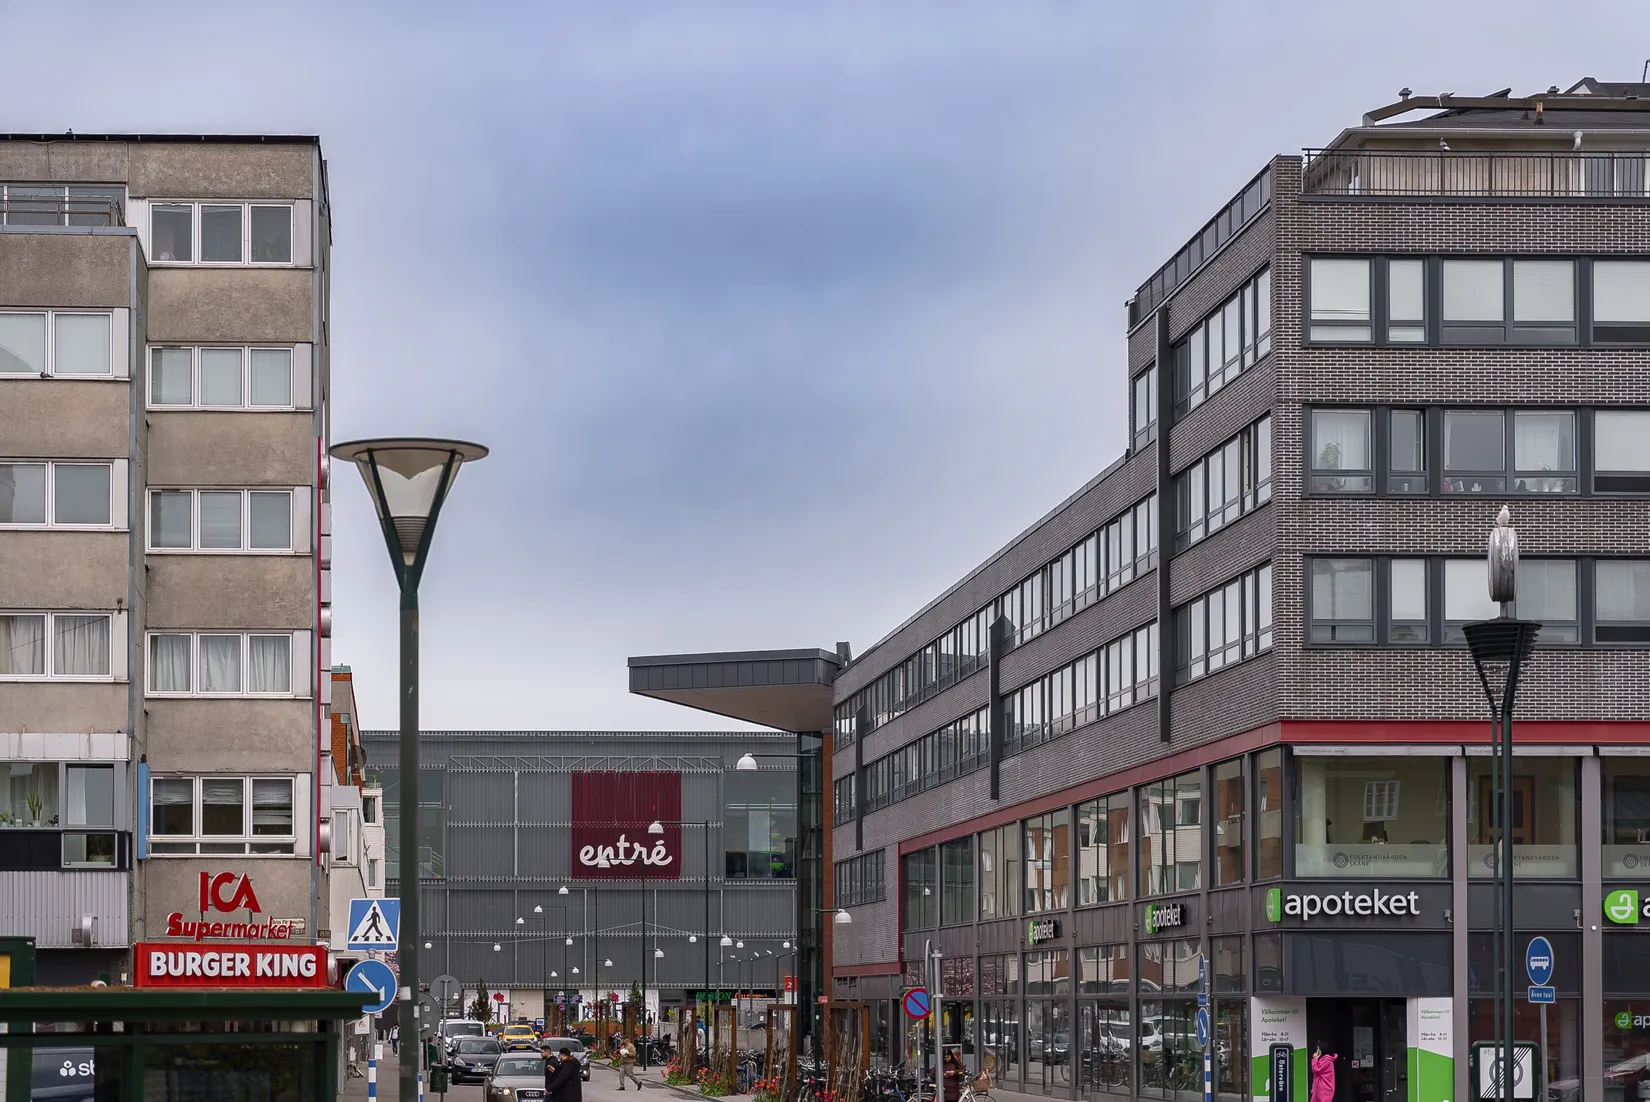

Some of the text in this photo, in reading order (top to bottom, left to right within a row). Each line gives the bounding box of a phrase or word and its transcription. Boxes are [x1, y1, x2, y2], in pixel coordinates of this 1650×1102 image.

[579, 834, 673, 866] entré
[1349, 853, 1408, 861] FOLKTANDVÅRDEN
[198, 871, 262, 913] ICA
[1284, 888, 1420, 921] apoteket
[165, 912, 294, 941] Supermarket
[1033, 919, 1054, 944] apoteket
[1152, 903, 1181, 932] apoteket
[149, 951, 317, 978] BURGER KING
[1531, 989, 1543, 998] Även
[1278, 1060, 1286, 1092] Östervärn
